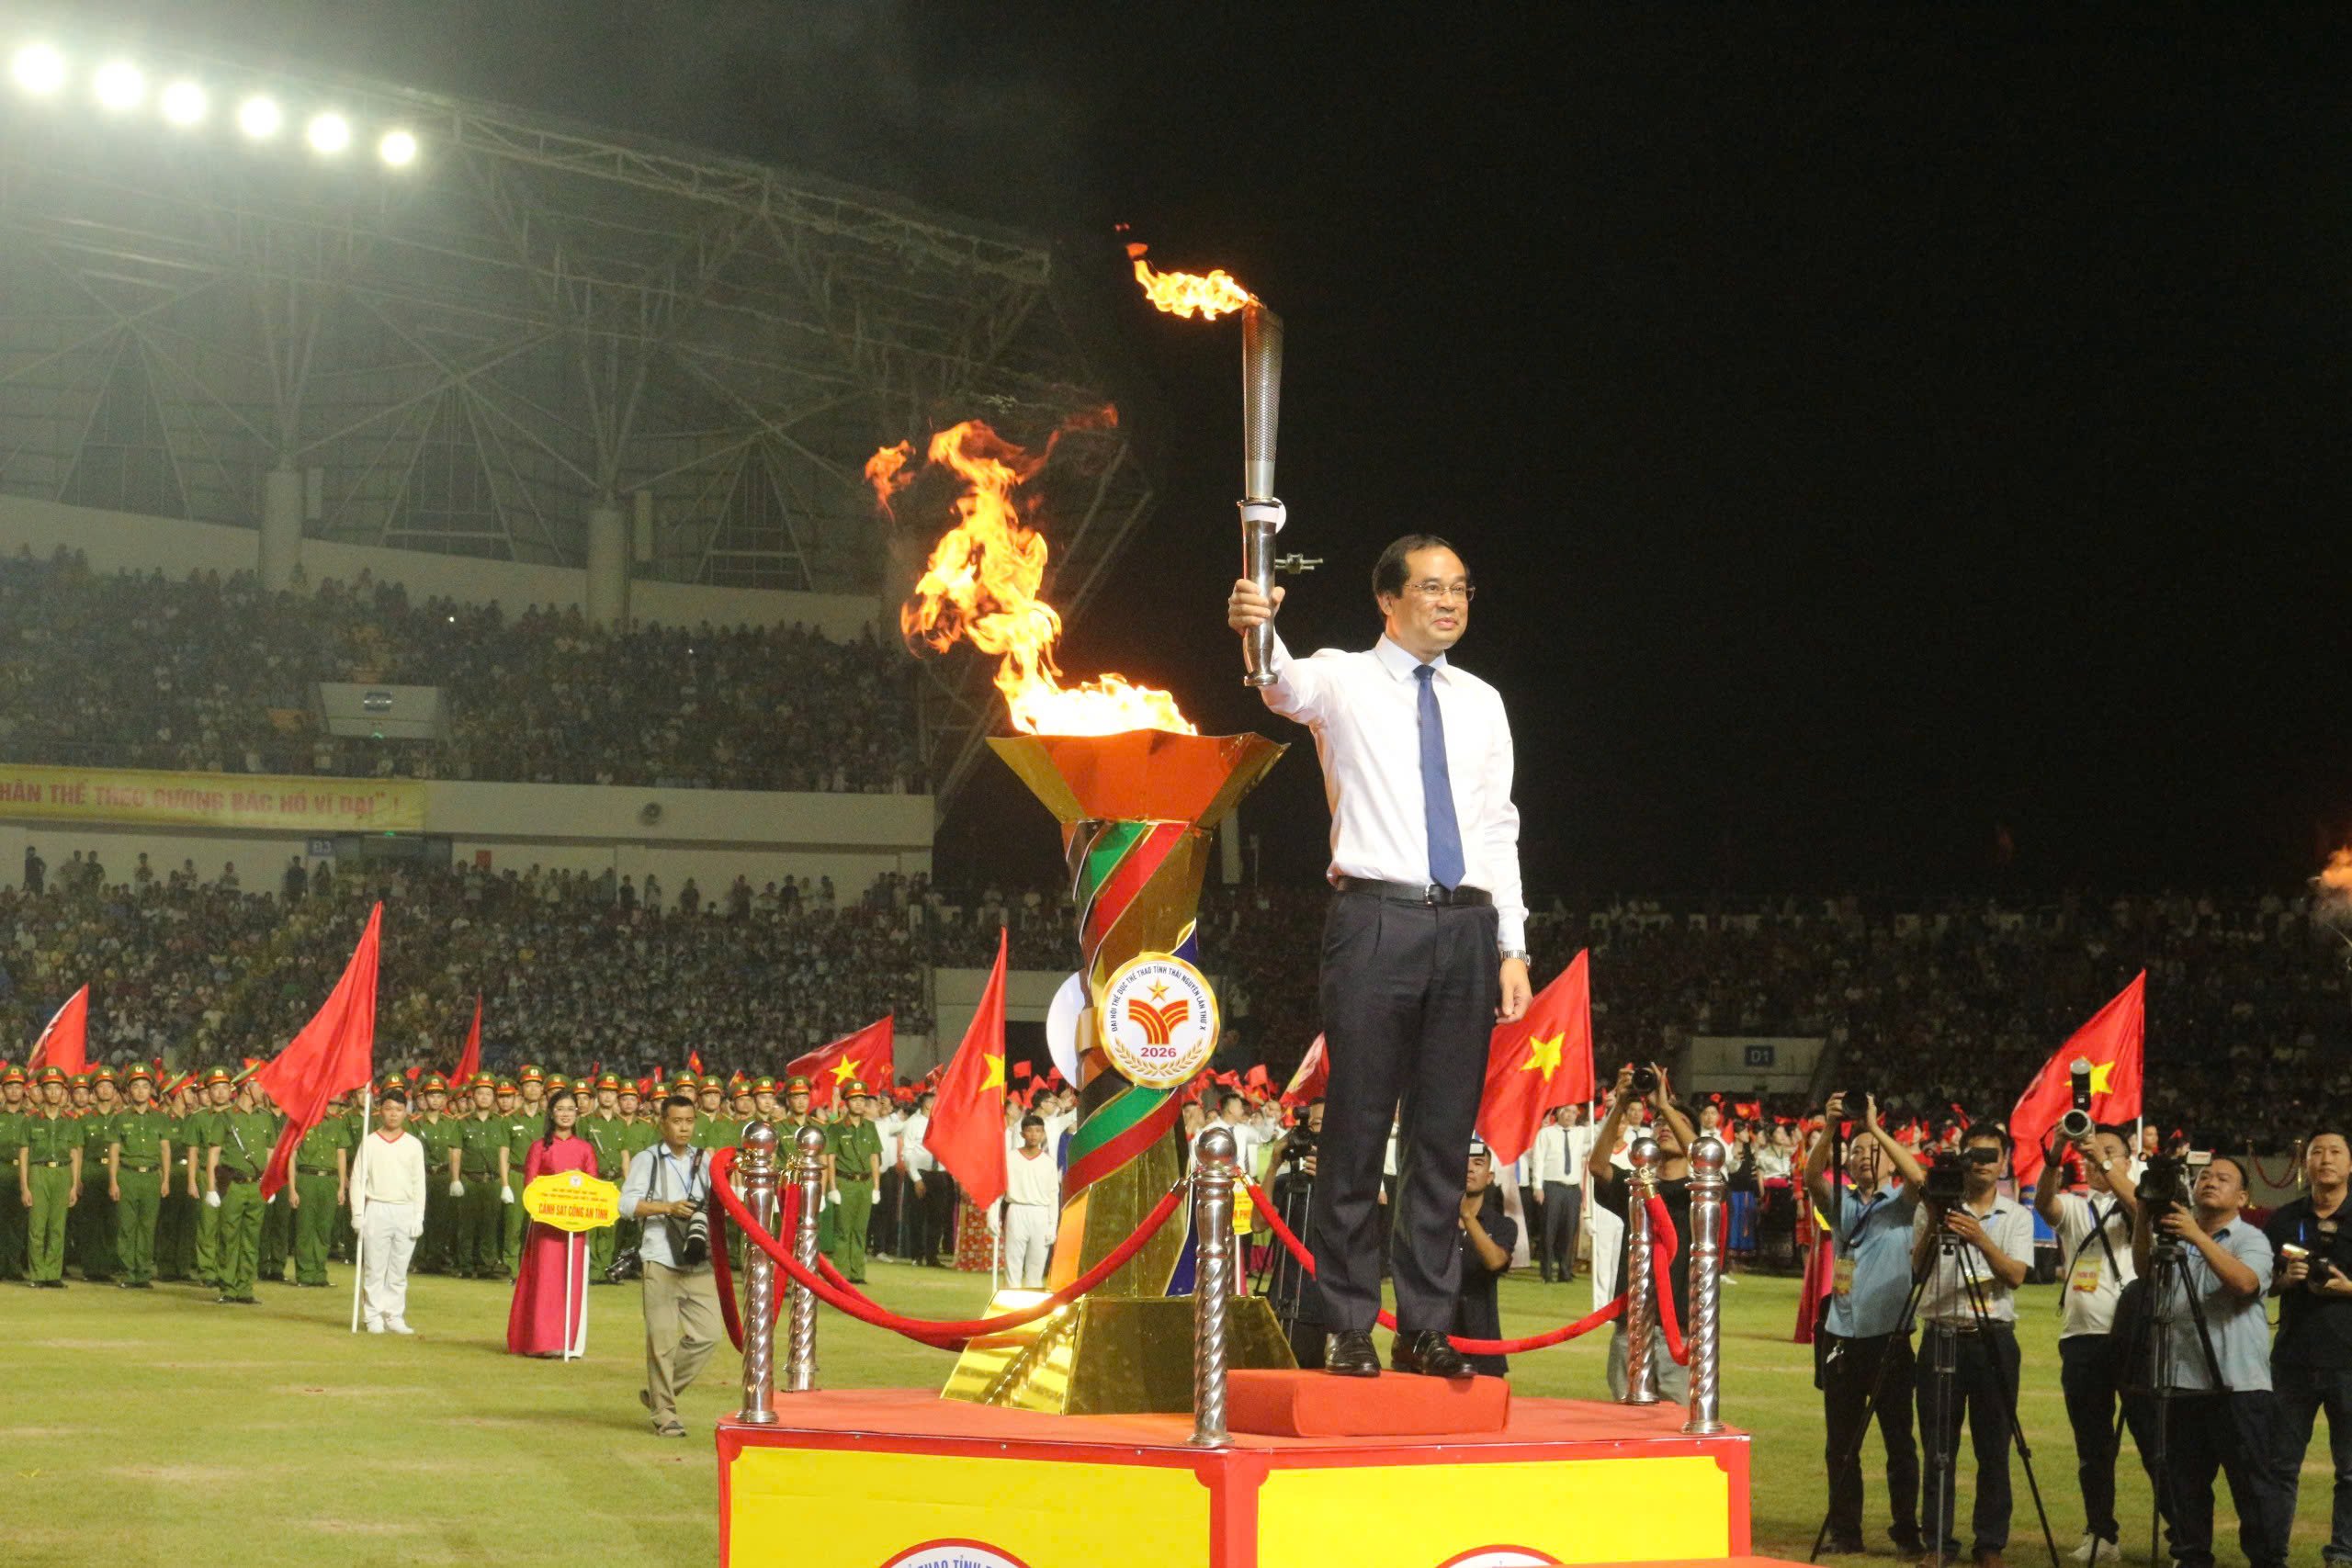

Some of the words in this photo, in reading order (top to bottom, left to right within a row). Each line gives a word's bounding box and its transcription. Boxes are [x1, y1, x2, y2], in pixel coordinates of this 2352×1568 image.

[1136, 966, 1152, 977] THAO
[1140, 1047, 1177, 1057] 2026
[1750, 1050, 1770, 1063] D1
